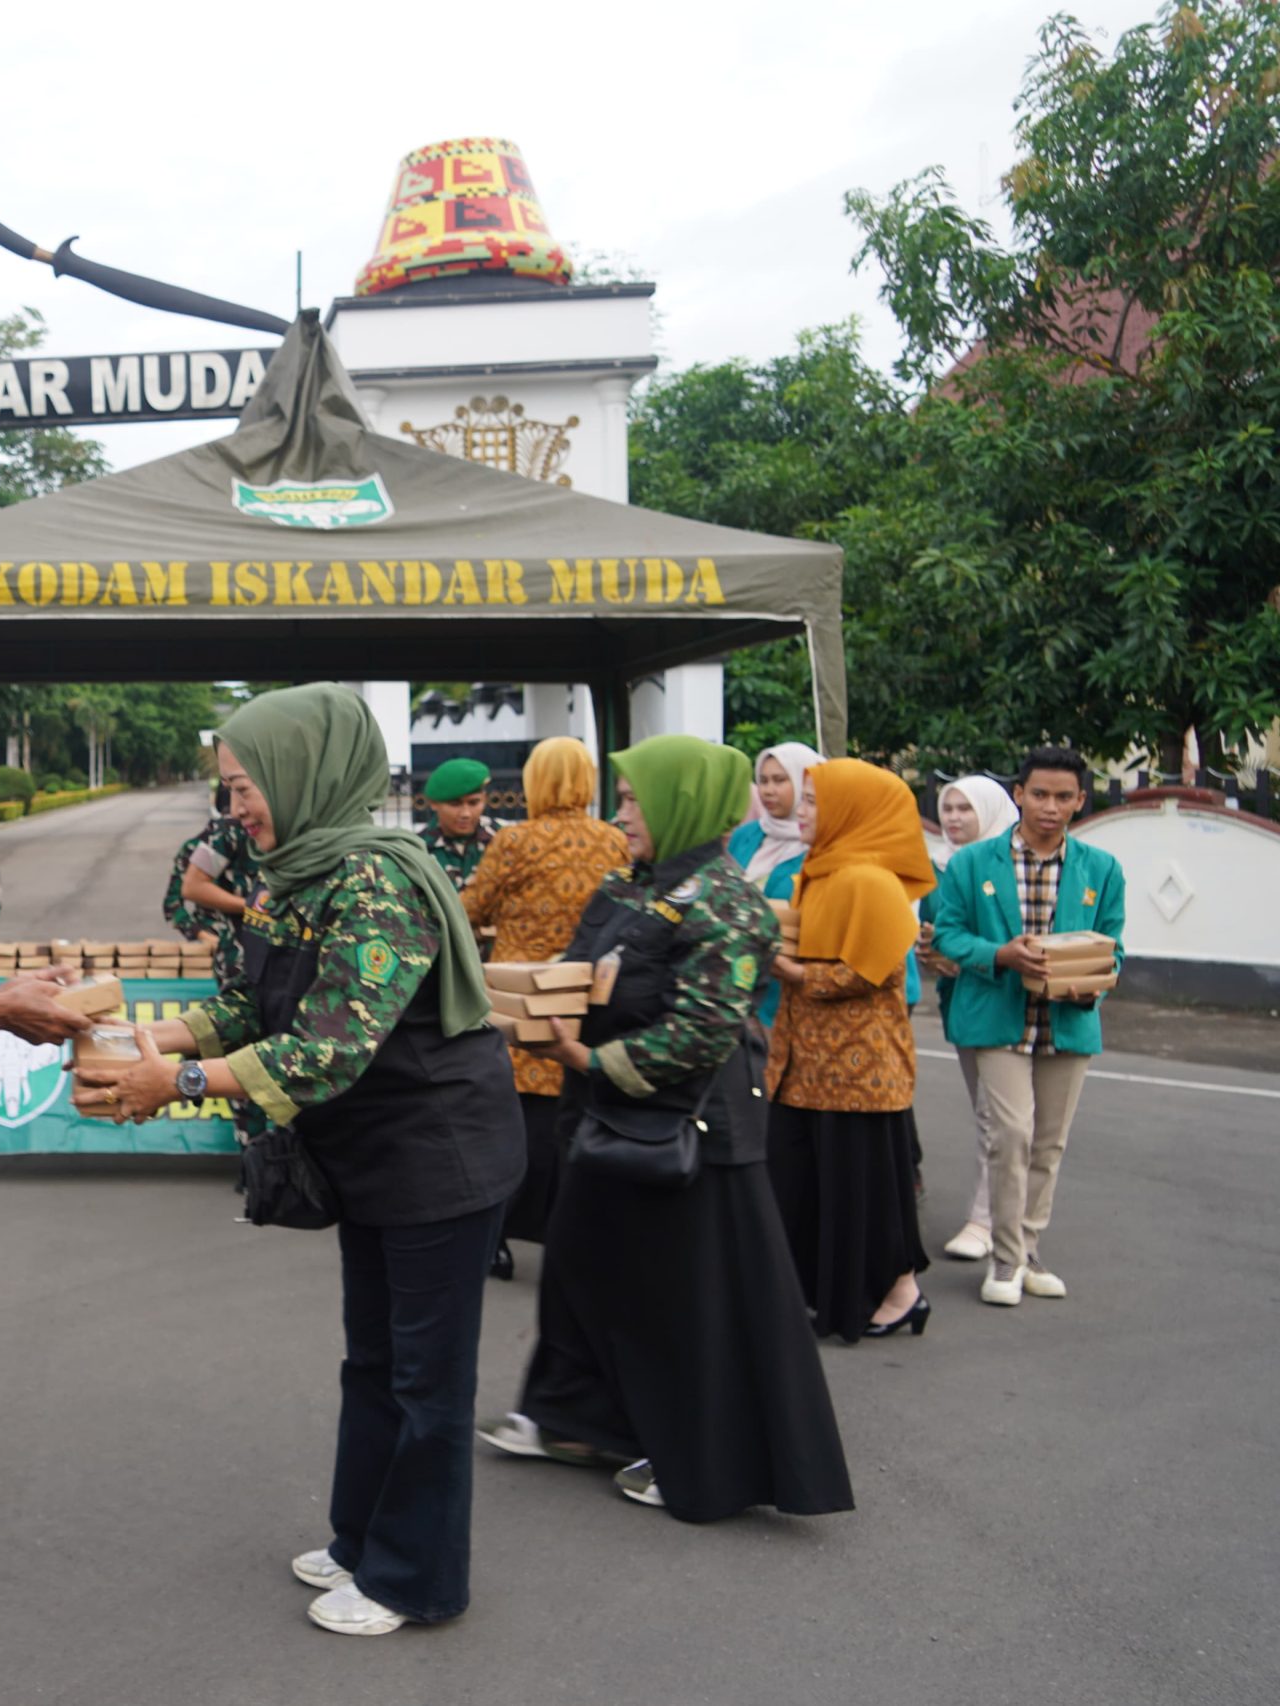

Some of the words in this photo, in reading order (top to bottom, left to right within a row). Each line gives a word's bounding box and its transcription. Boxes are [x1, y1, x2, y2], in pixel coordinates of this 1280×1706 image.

[90, 350, 267, 415] MUDA
[209, 560, 528, 605] ISKANDAR
[547, 557, 726, 605] MUDA
